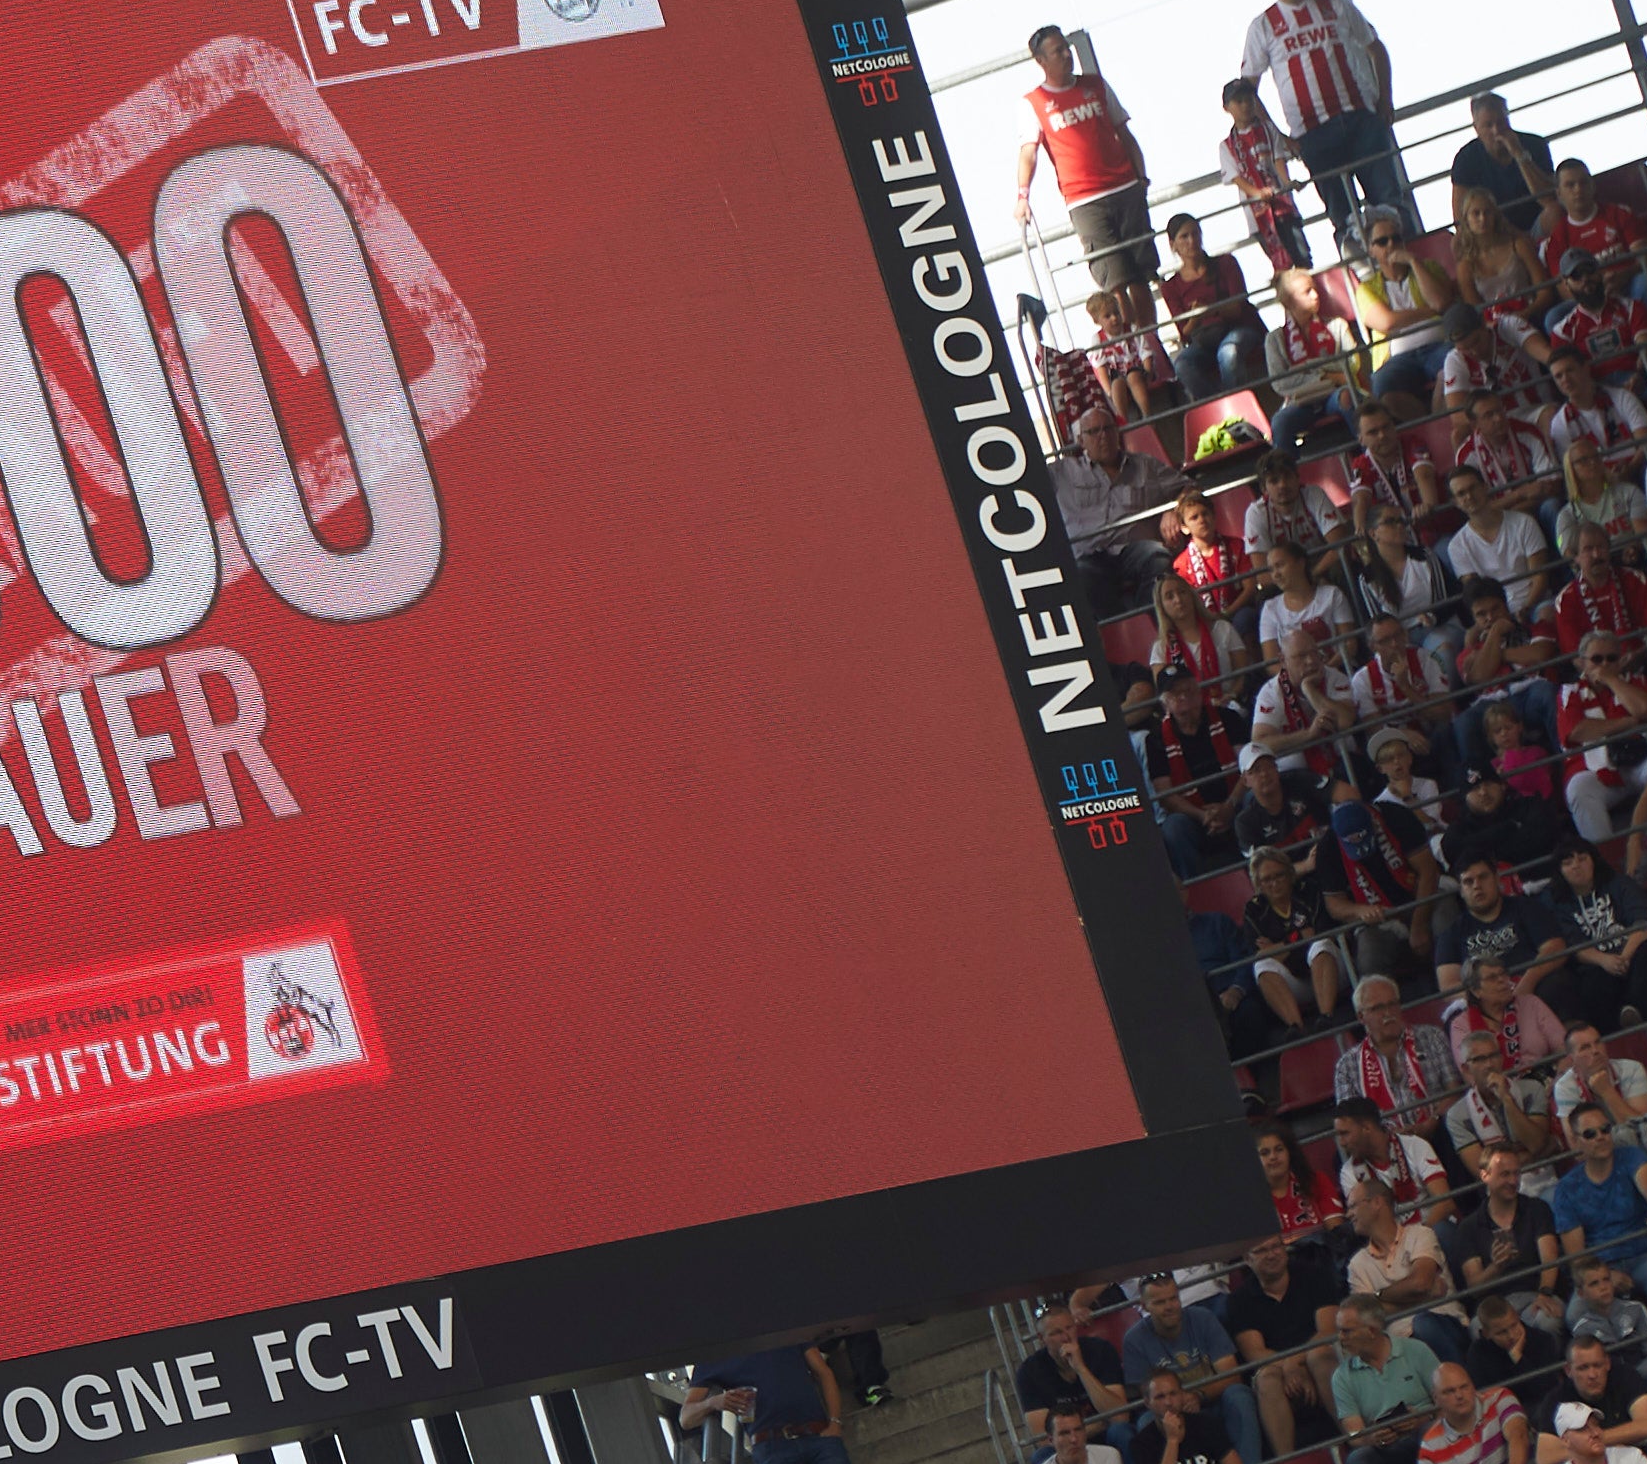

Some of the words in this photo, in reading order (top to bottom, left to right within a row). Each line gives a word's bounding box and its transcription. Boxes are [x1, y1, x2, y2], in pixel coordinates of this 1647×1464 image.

[1284, 23, 1338, 53] REWE
[832, 52, 911, 78] NETCOLOGNE
[1049, 100, 1104, 132] REWE
[871, 129, 1107, 735] NETCOLOGNE
[1060, 794, 1141, 820] NETCOLOGNE
[251, 1296, 456, 1404] FC-TV
